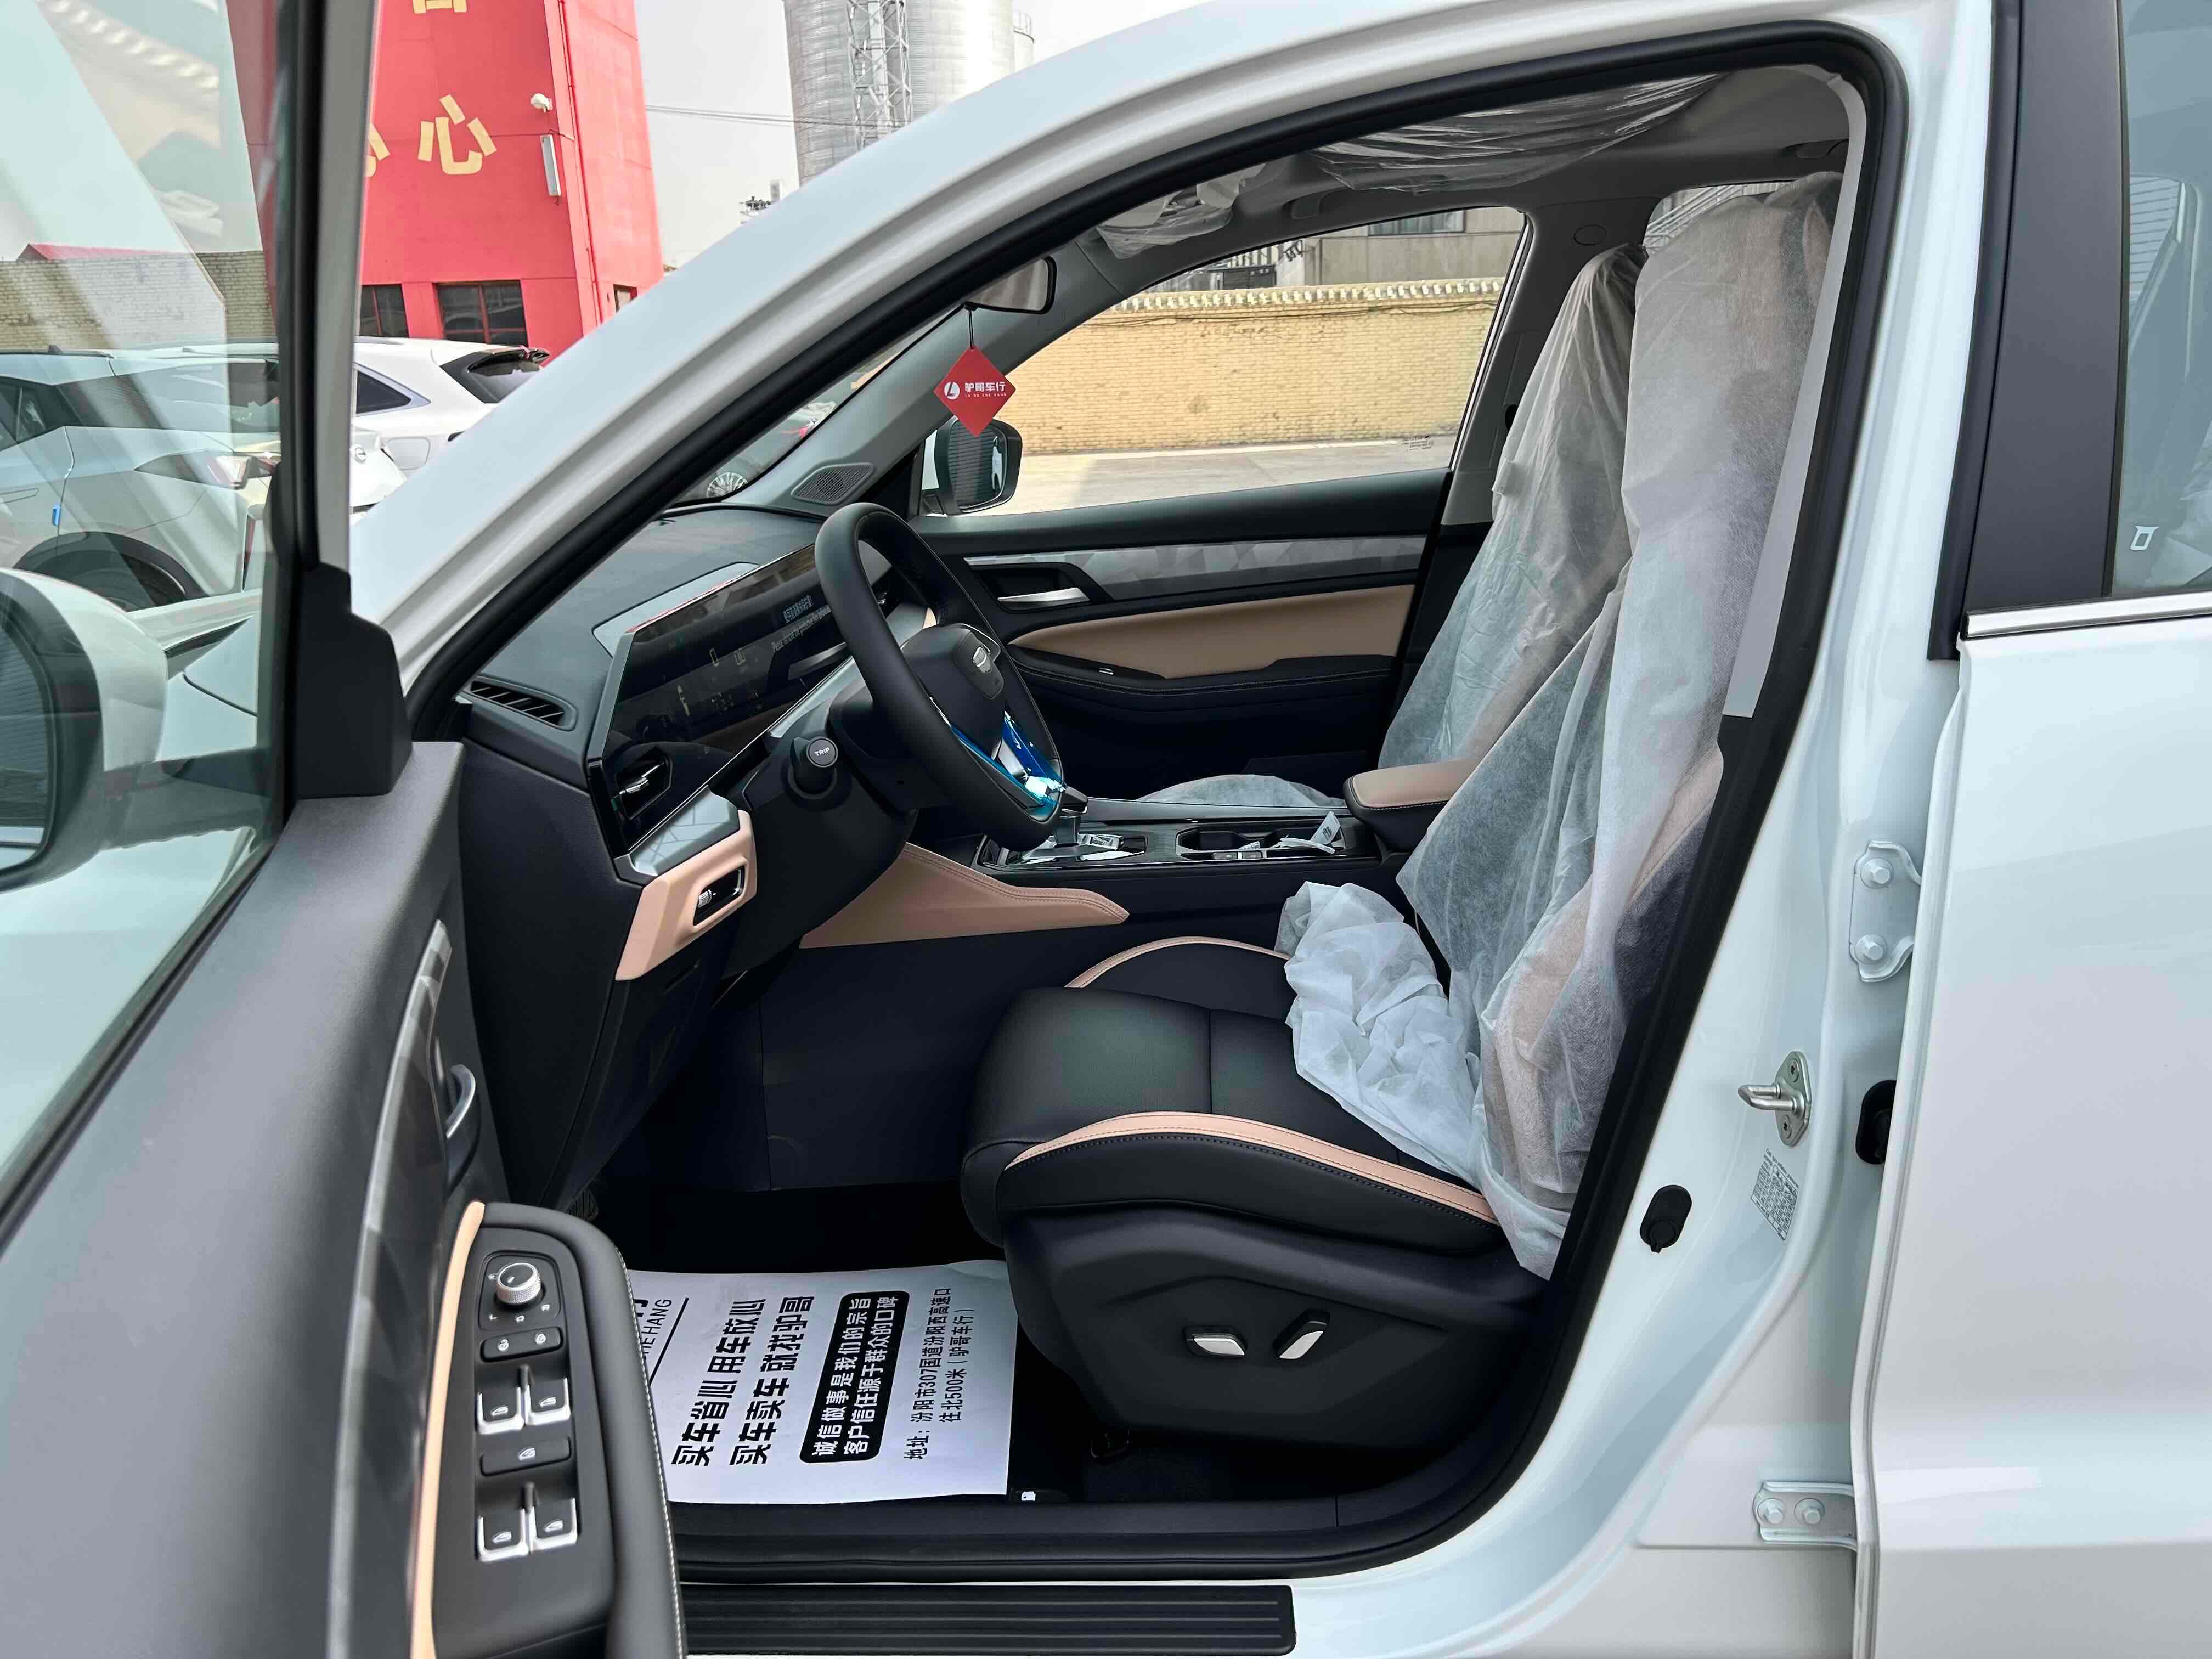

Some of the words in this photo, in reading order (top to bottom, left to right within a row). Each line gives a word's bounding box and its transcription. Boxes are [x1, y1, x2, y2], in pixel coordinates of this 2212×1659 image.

[418, 94, 496, 175] 心
[814, 747, 830, 756] TRIP
[641, 1299, 672, 1334] HANG
[671, 1380, 738, 1466] 买车省心
[707, 1299, 766, 1374] 用车放心
[729, 1378, 789, 1466] 买车卖车
[760, 1296, 815, 1373] 就找驴哥
[812, 1298, 871, 1457] 诚信做事是我们的宗旨
[844, 1296, 899, 1455] 客户信任源于群众的口碑
